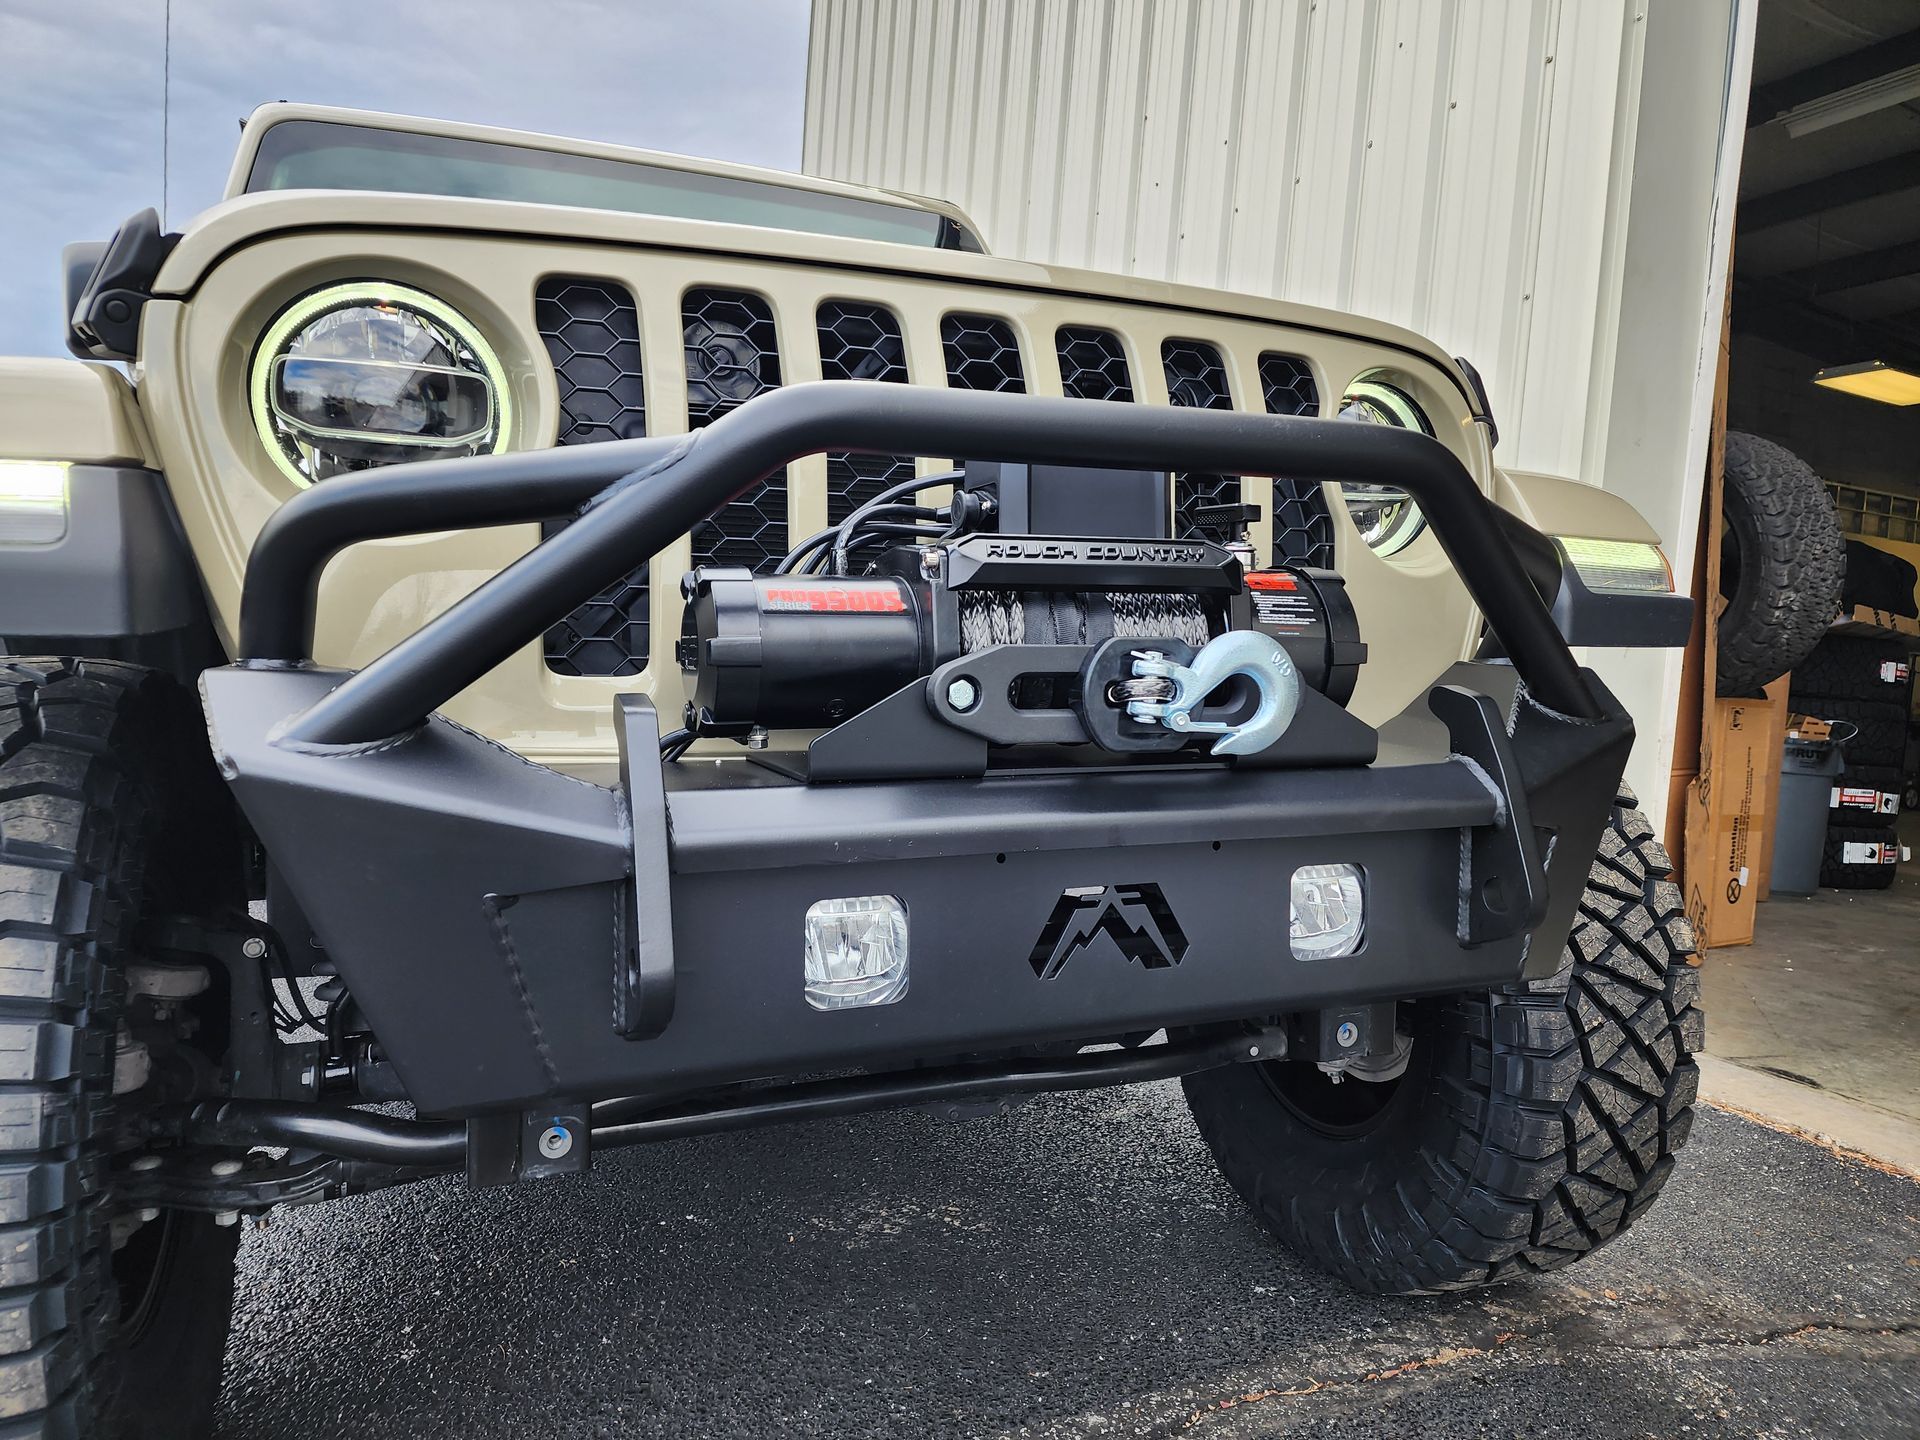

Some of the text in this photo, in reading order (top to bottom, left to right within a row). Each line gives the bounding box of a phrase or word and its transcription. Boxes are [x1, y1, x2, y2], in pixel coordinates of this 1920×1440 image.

[986, 543, 1205, 562] ROUGH COUNTRY
[769, 600, 811, 611] SERIES
[1729, 816, 1739, 872] Attention
